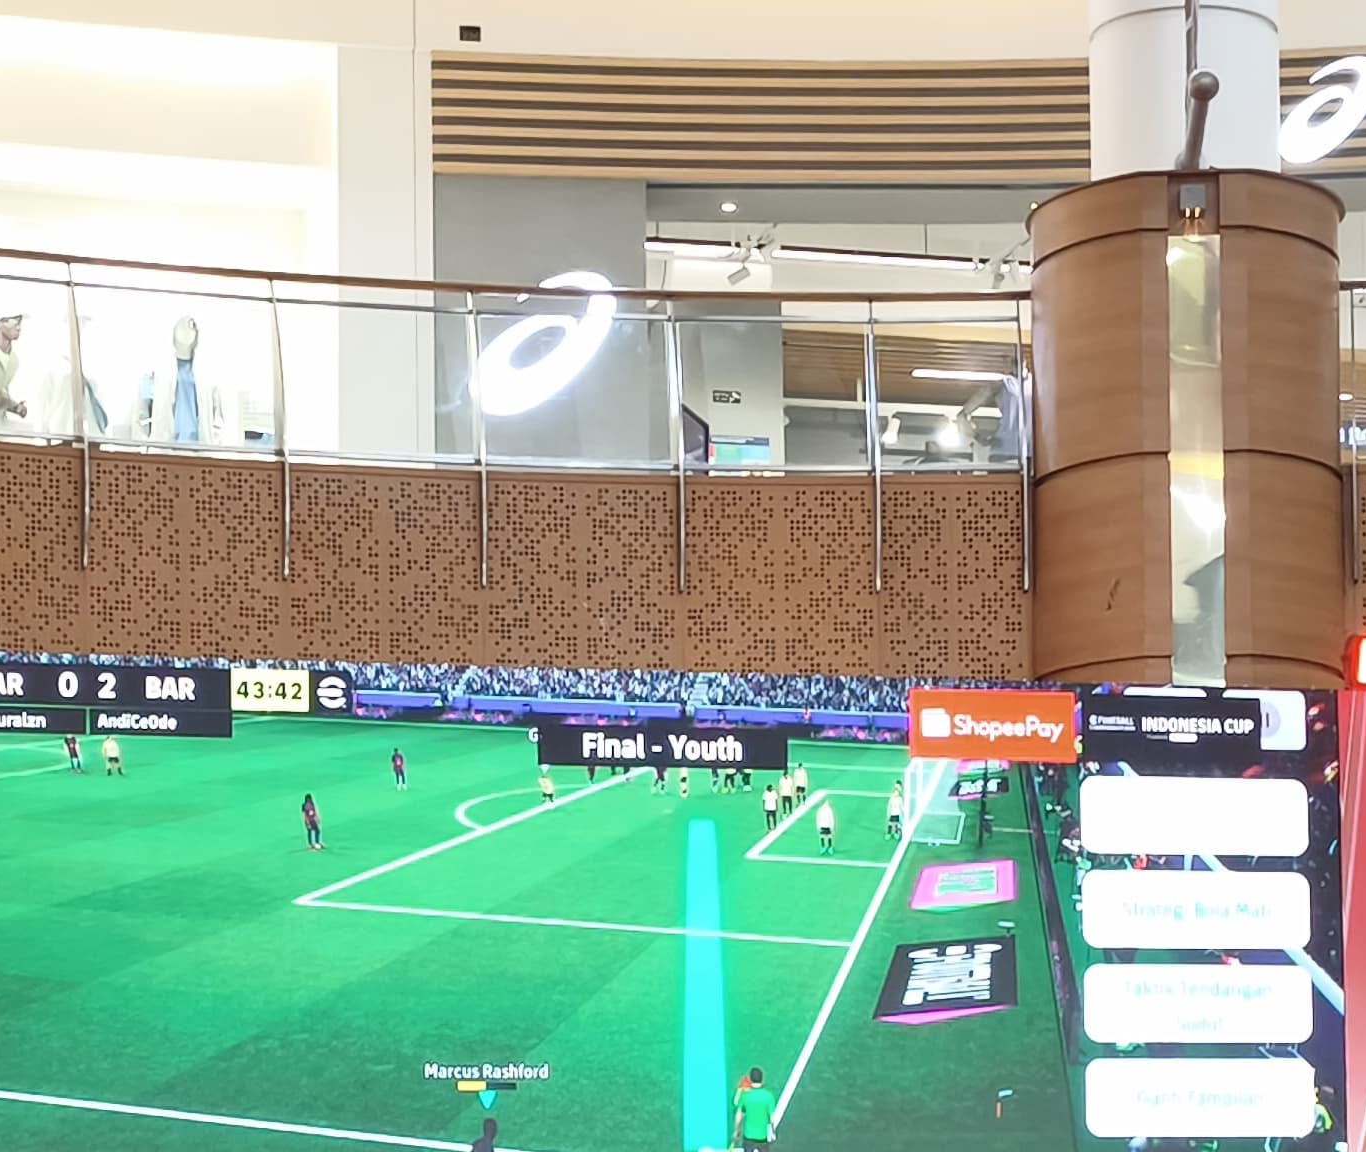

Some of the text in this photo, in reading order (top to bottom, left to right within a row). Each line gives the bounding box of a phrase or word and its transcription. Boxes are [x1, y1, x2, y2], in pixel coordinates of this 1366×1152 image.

[58, 671, 79, 698] 0
[97, 673, 117, 699] 2
[145, 675, 196, 701] BAR
[236, 679, 303, 700] 43:42
[952, 714, 1065, 743] ShopeePay
[1141, 716, 1223, 735] INDONESIA
[1223, 718, 1255, 735] CUP
[581, 731, 646, 760] Final
[668, 734, 743, 763] Youth
[424, 1063, 549, 1079] Marcus Rashford
